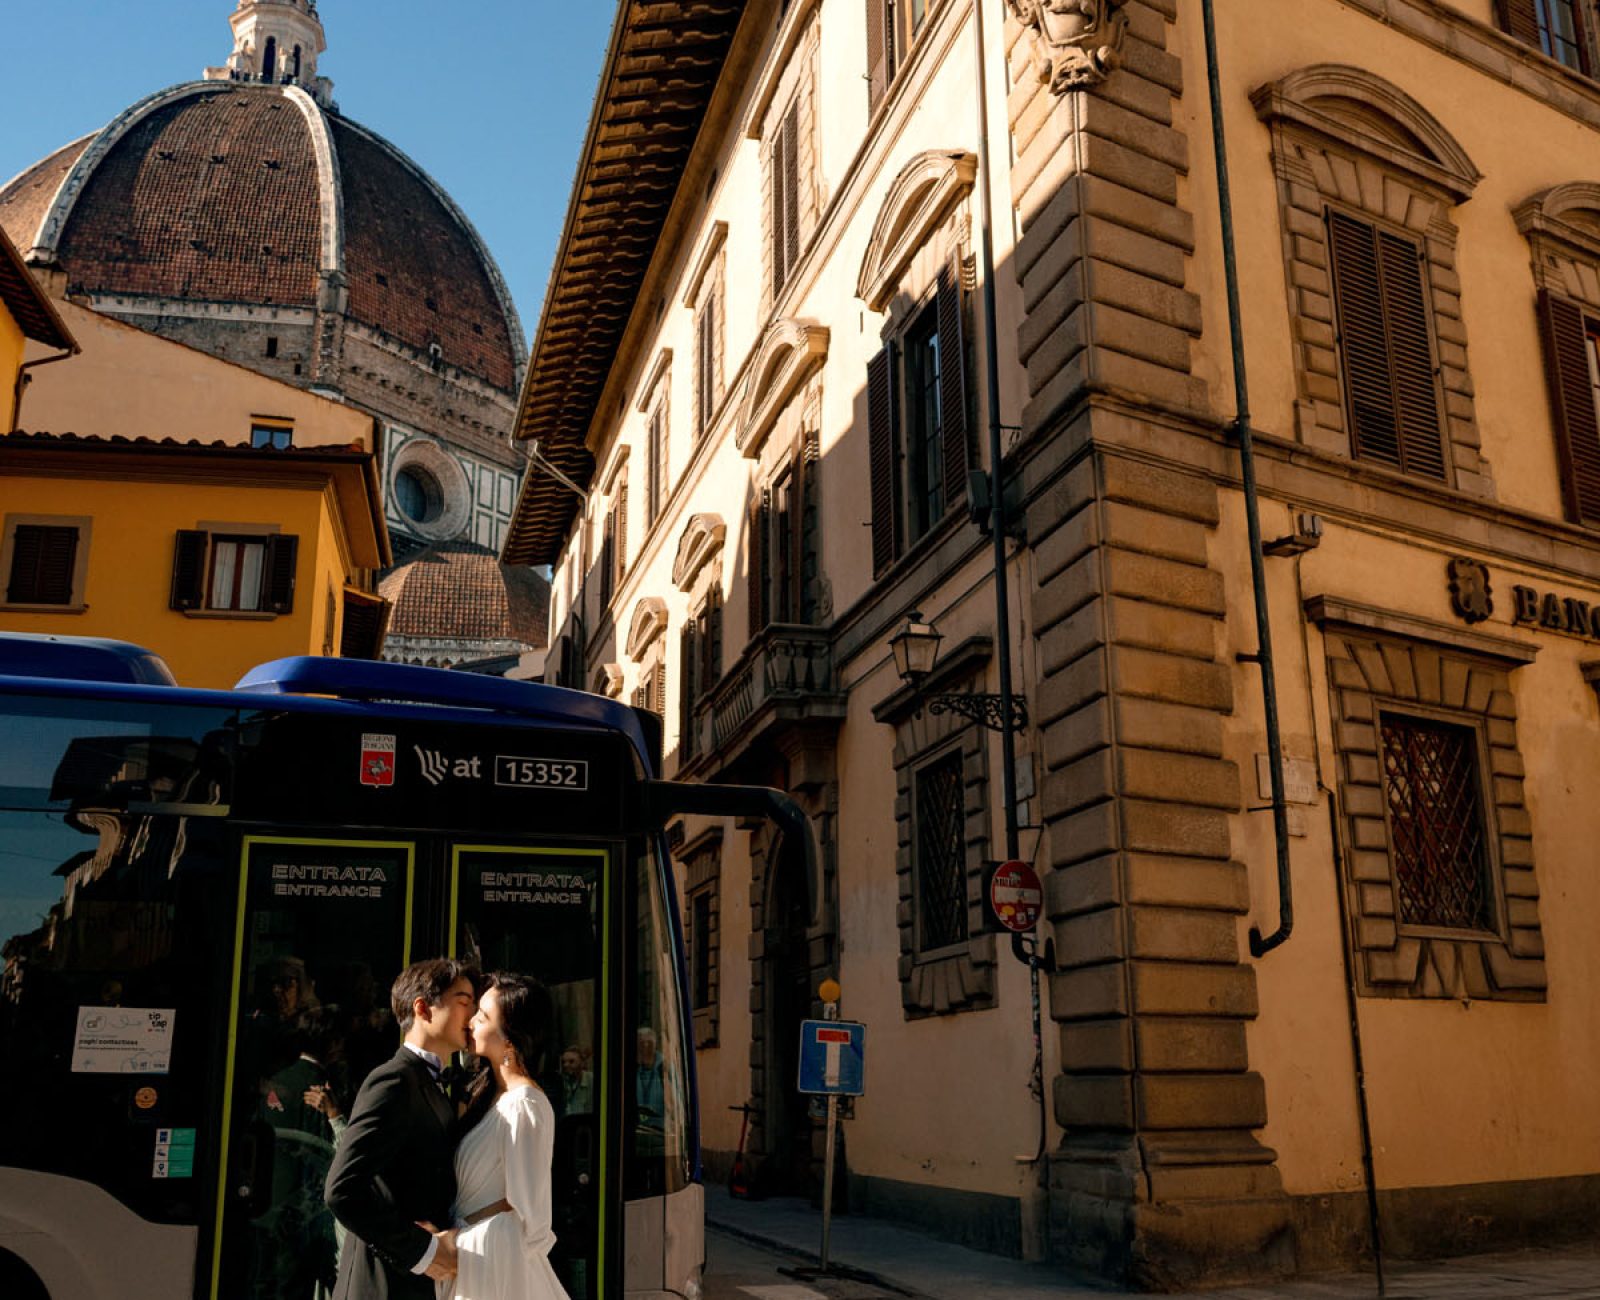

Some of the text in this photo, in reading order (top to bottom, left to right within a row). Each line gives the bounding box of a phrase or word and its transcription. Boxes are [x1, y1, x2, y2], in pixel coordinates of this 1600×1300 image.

[452, 755, 481, 778] at
[506, 762, 577, 785] 15352
[271, 863, 387, 882] ENTRATA
[480, 871, 586, 889] ENTRATA
[273, 883, 383, 898] ENTRANCE
[483, 890, 582, 904] ENTRANCE
[148, 1011, 161, 1021] tip
